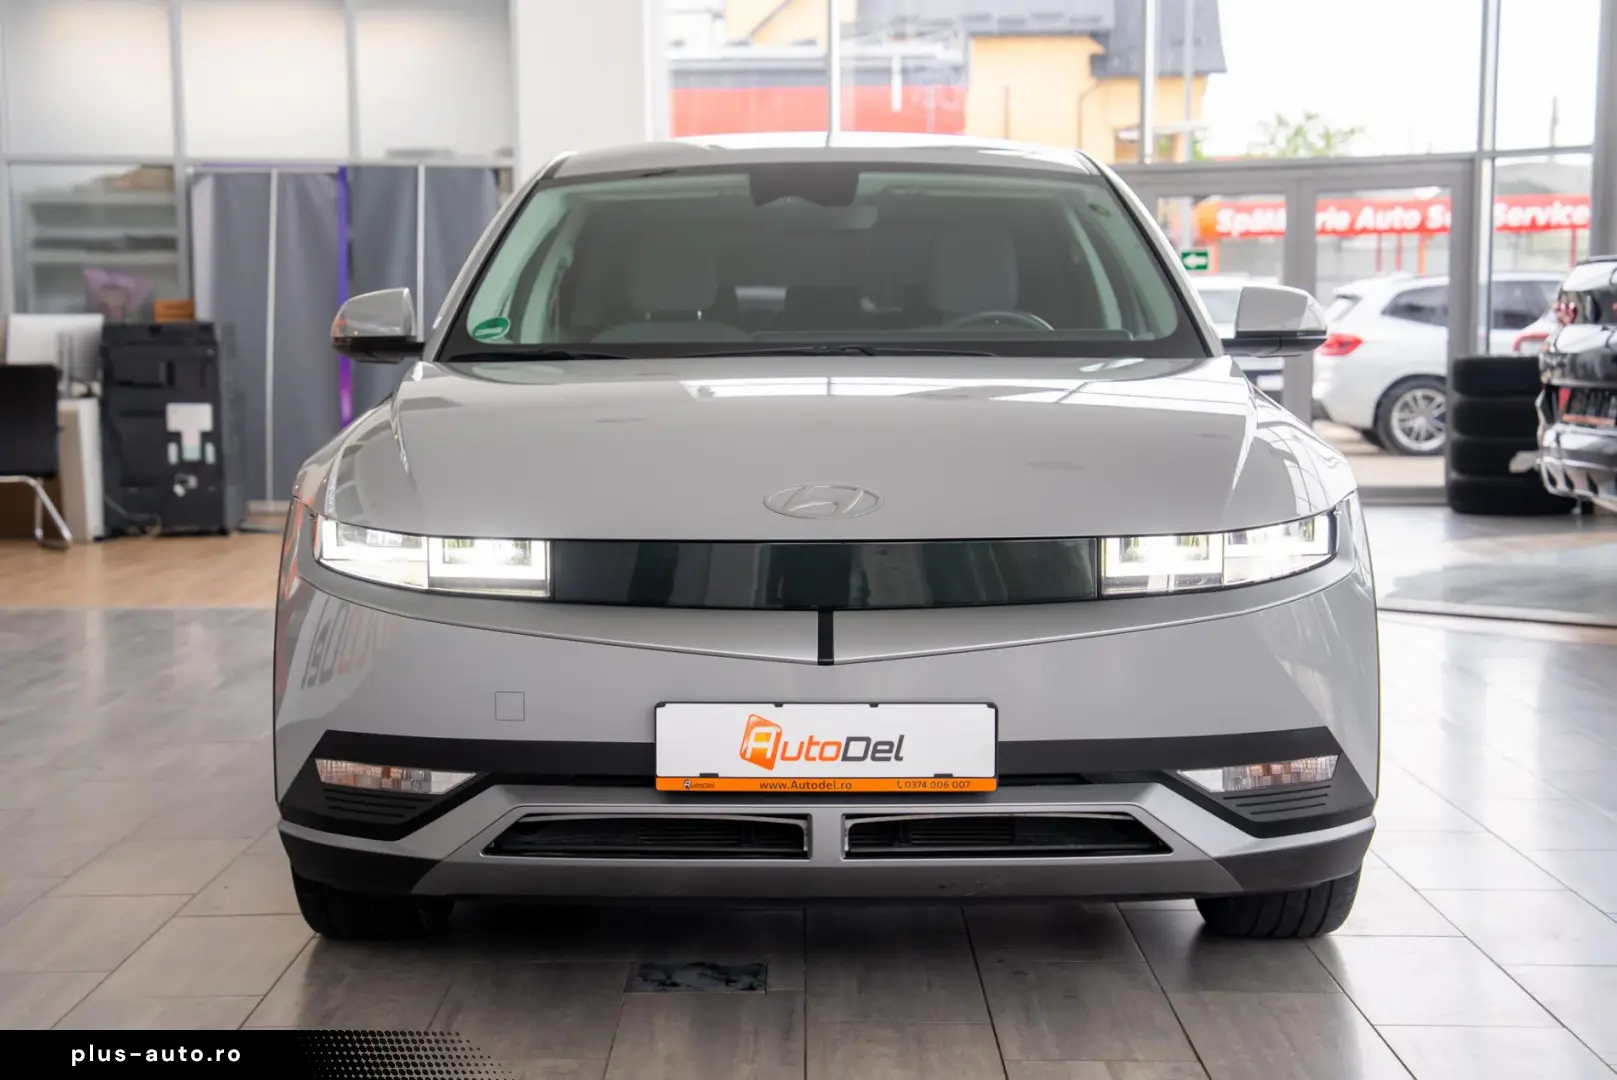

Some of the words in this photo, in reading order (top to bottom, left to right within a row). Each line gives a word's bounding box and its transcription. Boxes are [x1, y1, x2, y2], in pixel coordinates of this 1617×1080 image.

[1354, 205, 1421, 230] Auto
[741, 718, 904, 767] AutoDel
[759, 780, 853, 790] www.Autodel.ro
[904, 780, 927, 789] 0374
[930, 780, 950, 789] 006
[952, 780, 971, 789] 007
